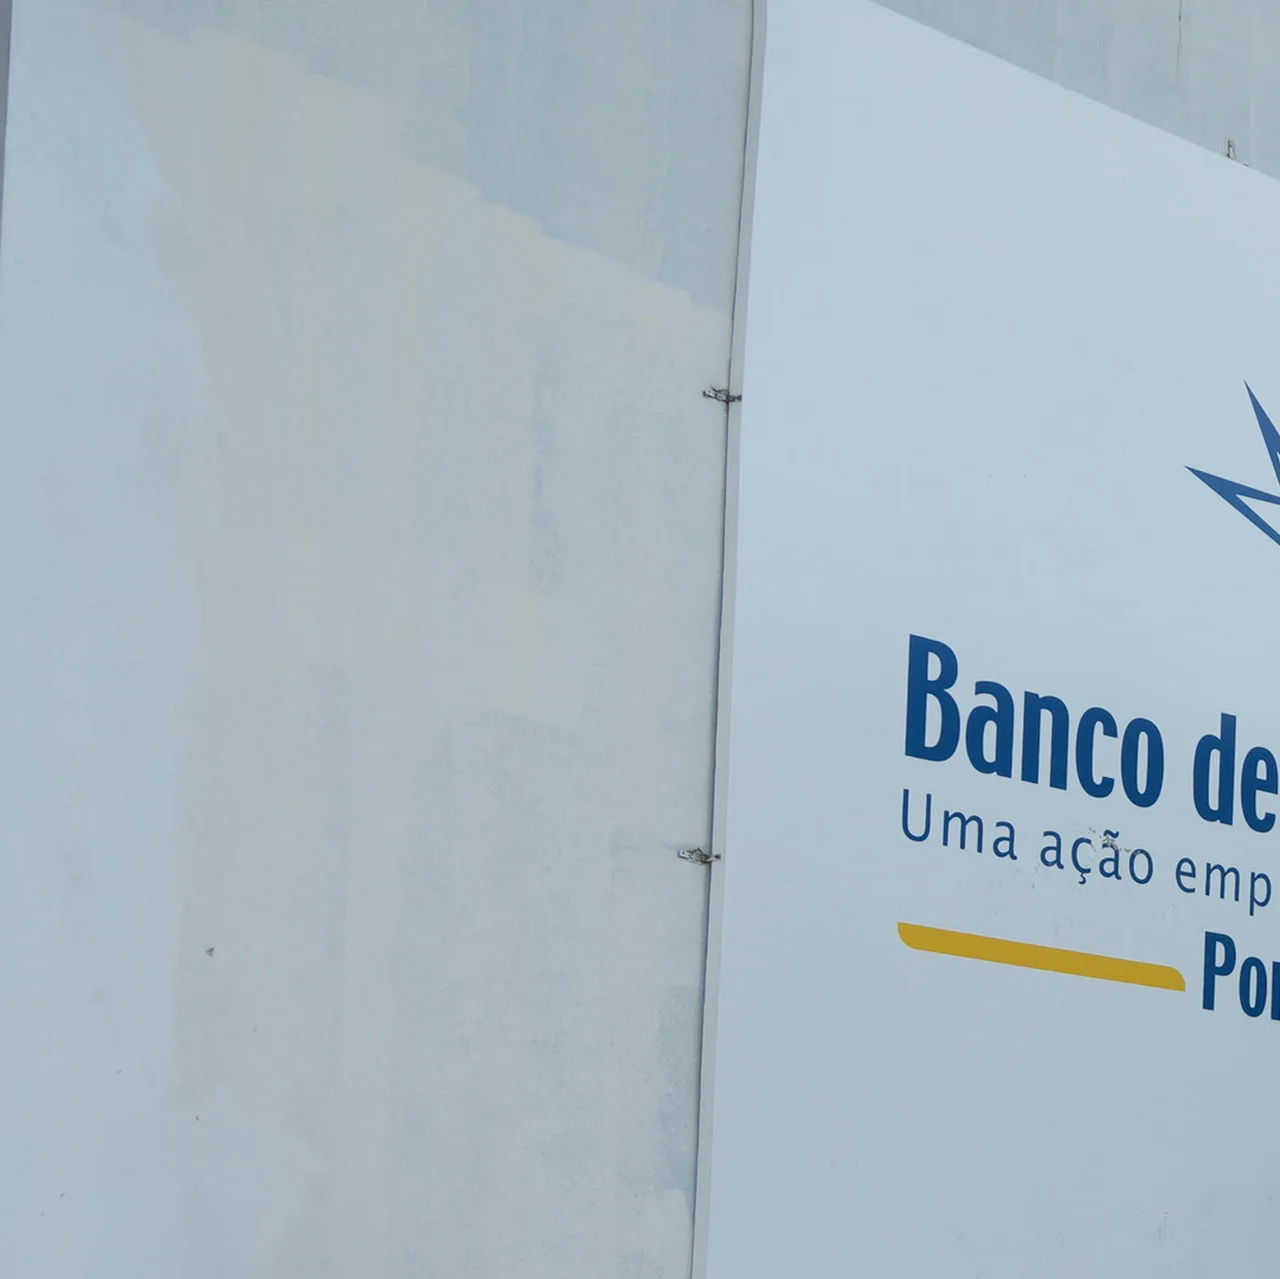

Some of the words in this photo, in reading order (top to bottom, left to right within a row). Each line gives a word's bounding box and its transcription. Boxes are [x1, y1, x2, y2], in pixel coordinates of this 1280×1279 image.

[904, 633, 1165, 808] Banco
[1192, 712, 1279, 834] de
[902, 788, 1018, 861] Uma
[1040, 829, 1154, 886] ação
